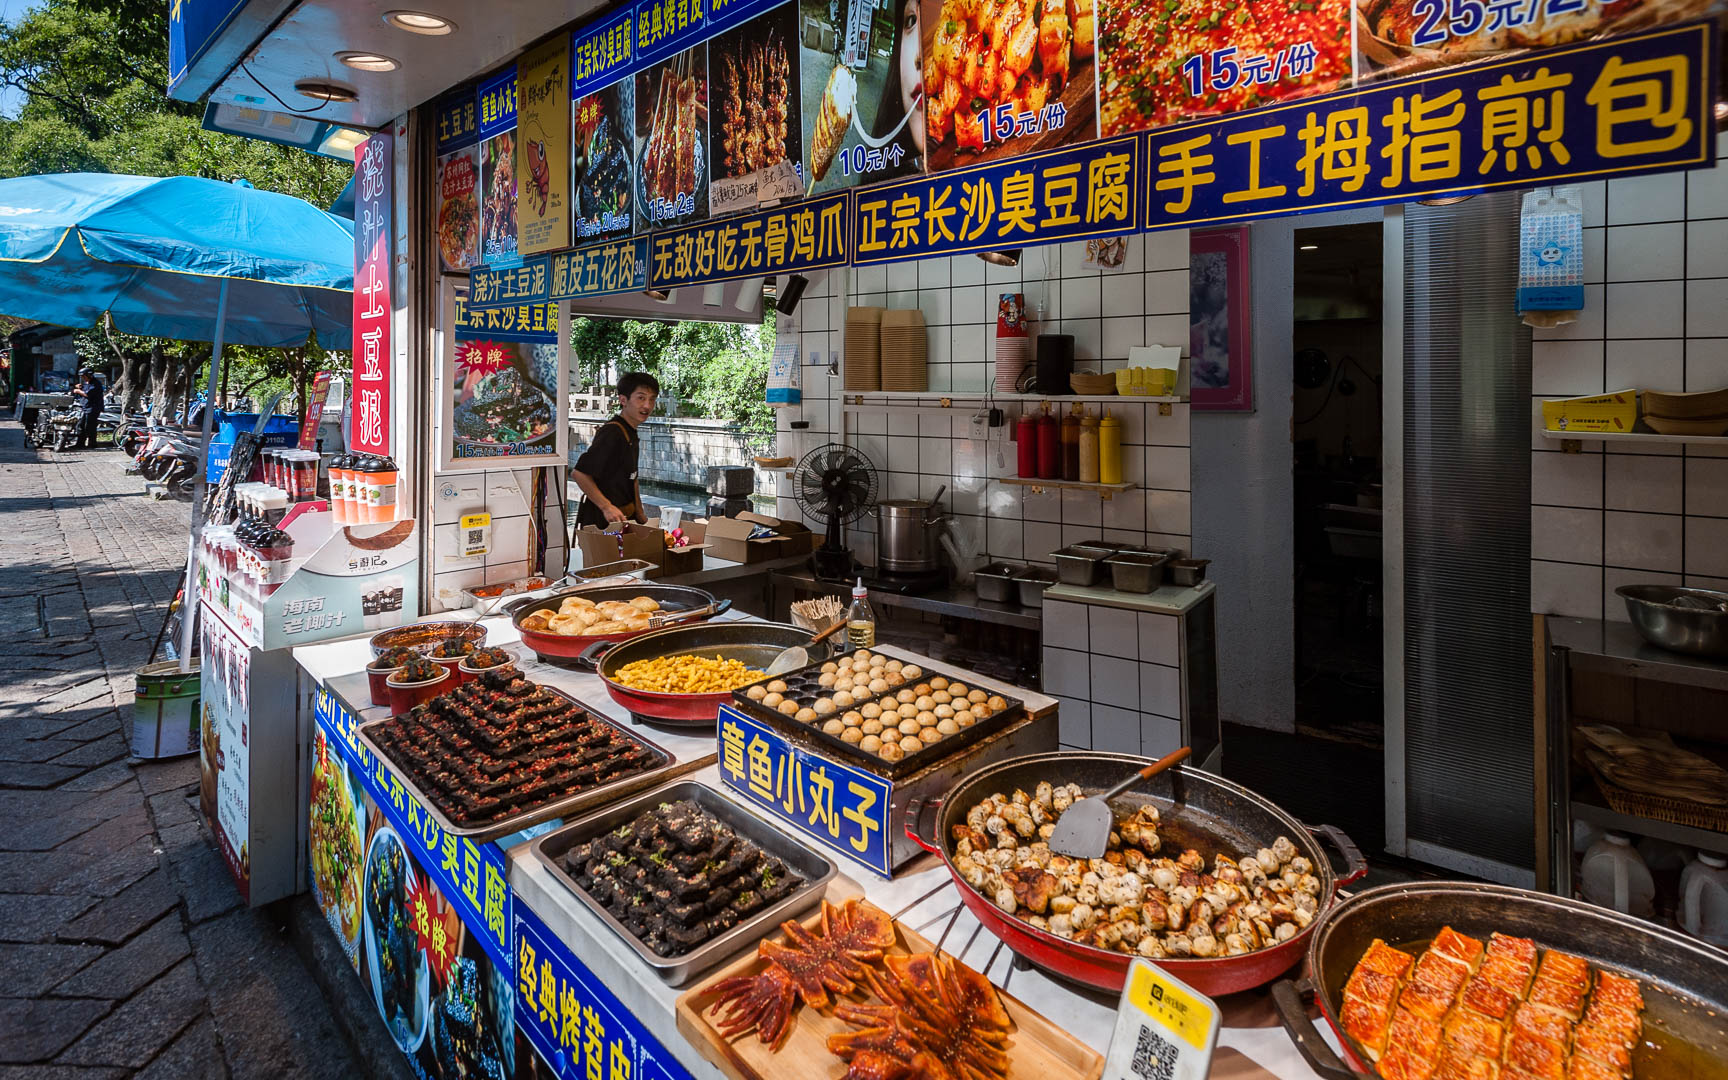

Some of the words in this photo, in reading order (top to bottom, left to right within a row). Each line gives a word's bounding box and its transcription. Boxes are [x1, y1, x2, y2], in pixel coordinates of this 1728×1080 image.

[576, 18, 631, 80] 正宗长沙臭豆腐
[1183, 41, 1317, 97] 15元/份
[440, 102, 475, 141] 土豆泥
[580, 101, 598, 125] 招牌
[977, 102, 1067, 143] 15元/份
[1155, 54, 1692, 214] 手工拇指煎包
[839, 143, 905, 175] 10元/个
[649, 192, 694, 222] 15元/2串
[858, 152, 1130, 252] 正宗长沙臭豆腐
[653, 202, 844, 281] 无敌好吃无骨鸡爪
[473, 264, 545, 303] 浇汁土豆泥
[551, 241, 636, 297] 脆皮五花肉
[360, 140, 385, 447] 浇汁土豆泥
[465, 349, 504, 368] 招牌
[282, 596, 325, 617] 海南
[282, 611, 346, 635] 老椰汁
[721, 721, 879, 853] 章鱼小丸子
[415, 892, 447, 969] 招牌
